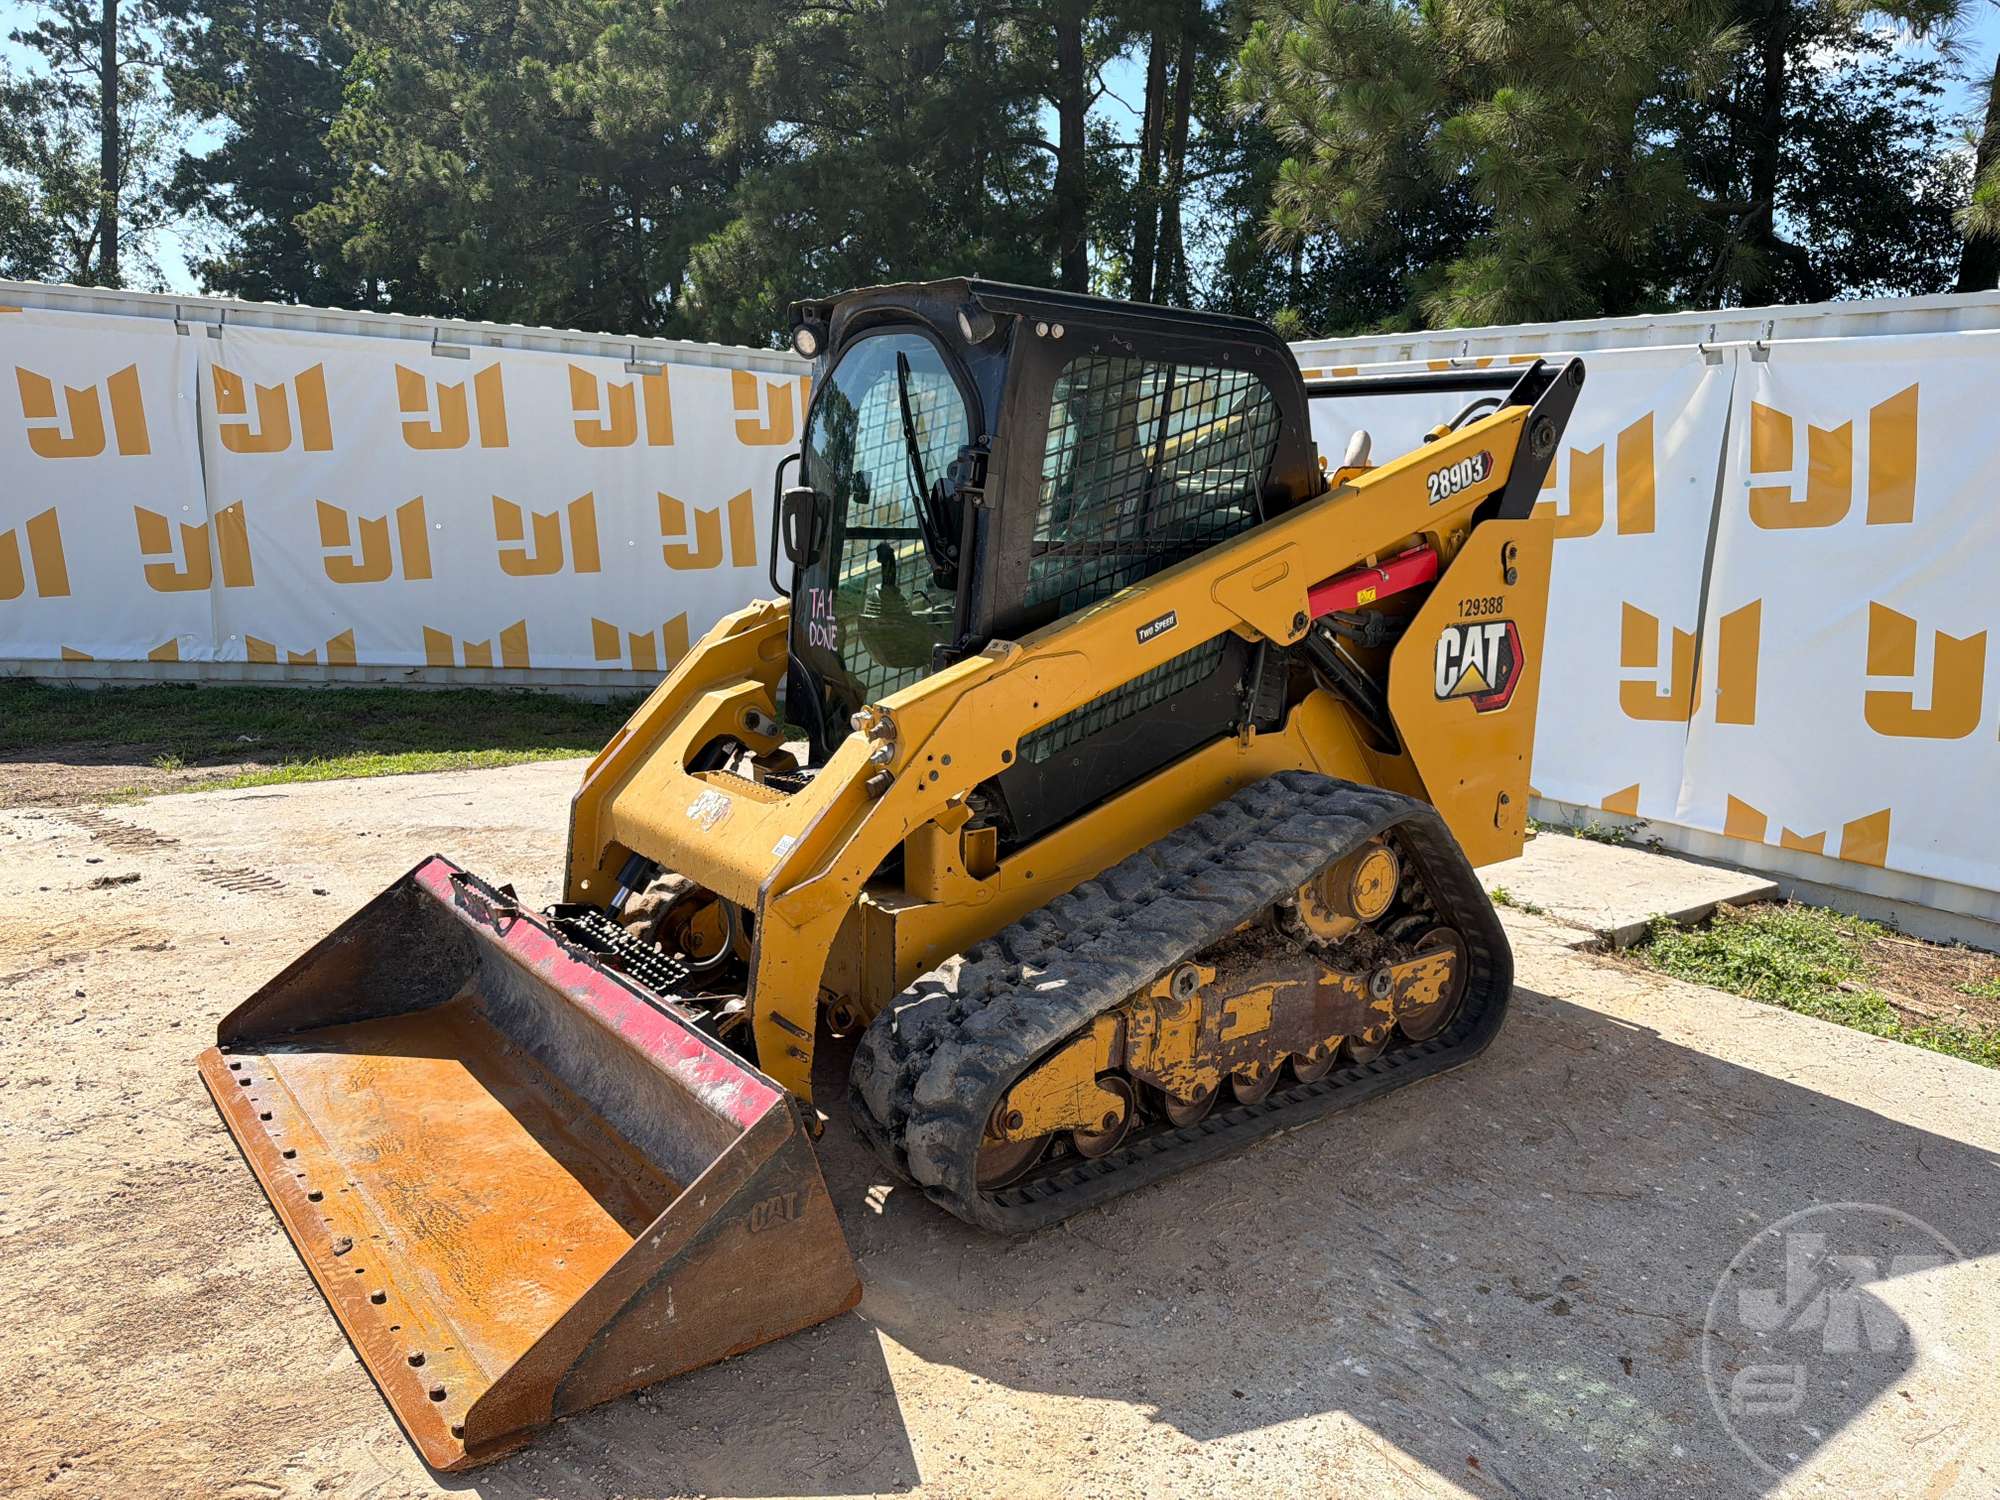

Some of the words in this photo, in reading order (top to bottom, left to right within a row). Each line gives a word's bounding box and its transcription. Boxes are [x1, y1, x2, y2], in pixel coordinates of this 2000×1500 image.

[1427, 455, 1484, 504] 289D3
[1458, 596, 1504, 617] 129388
[809, 621, 838, 651] DONE
[1435, 622, 1506, 697] CAT
